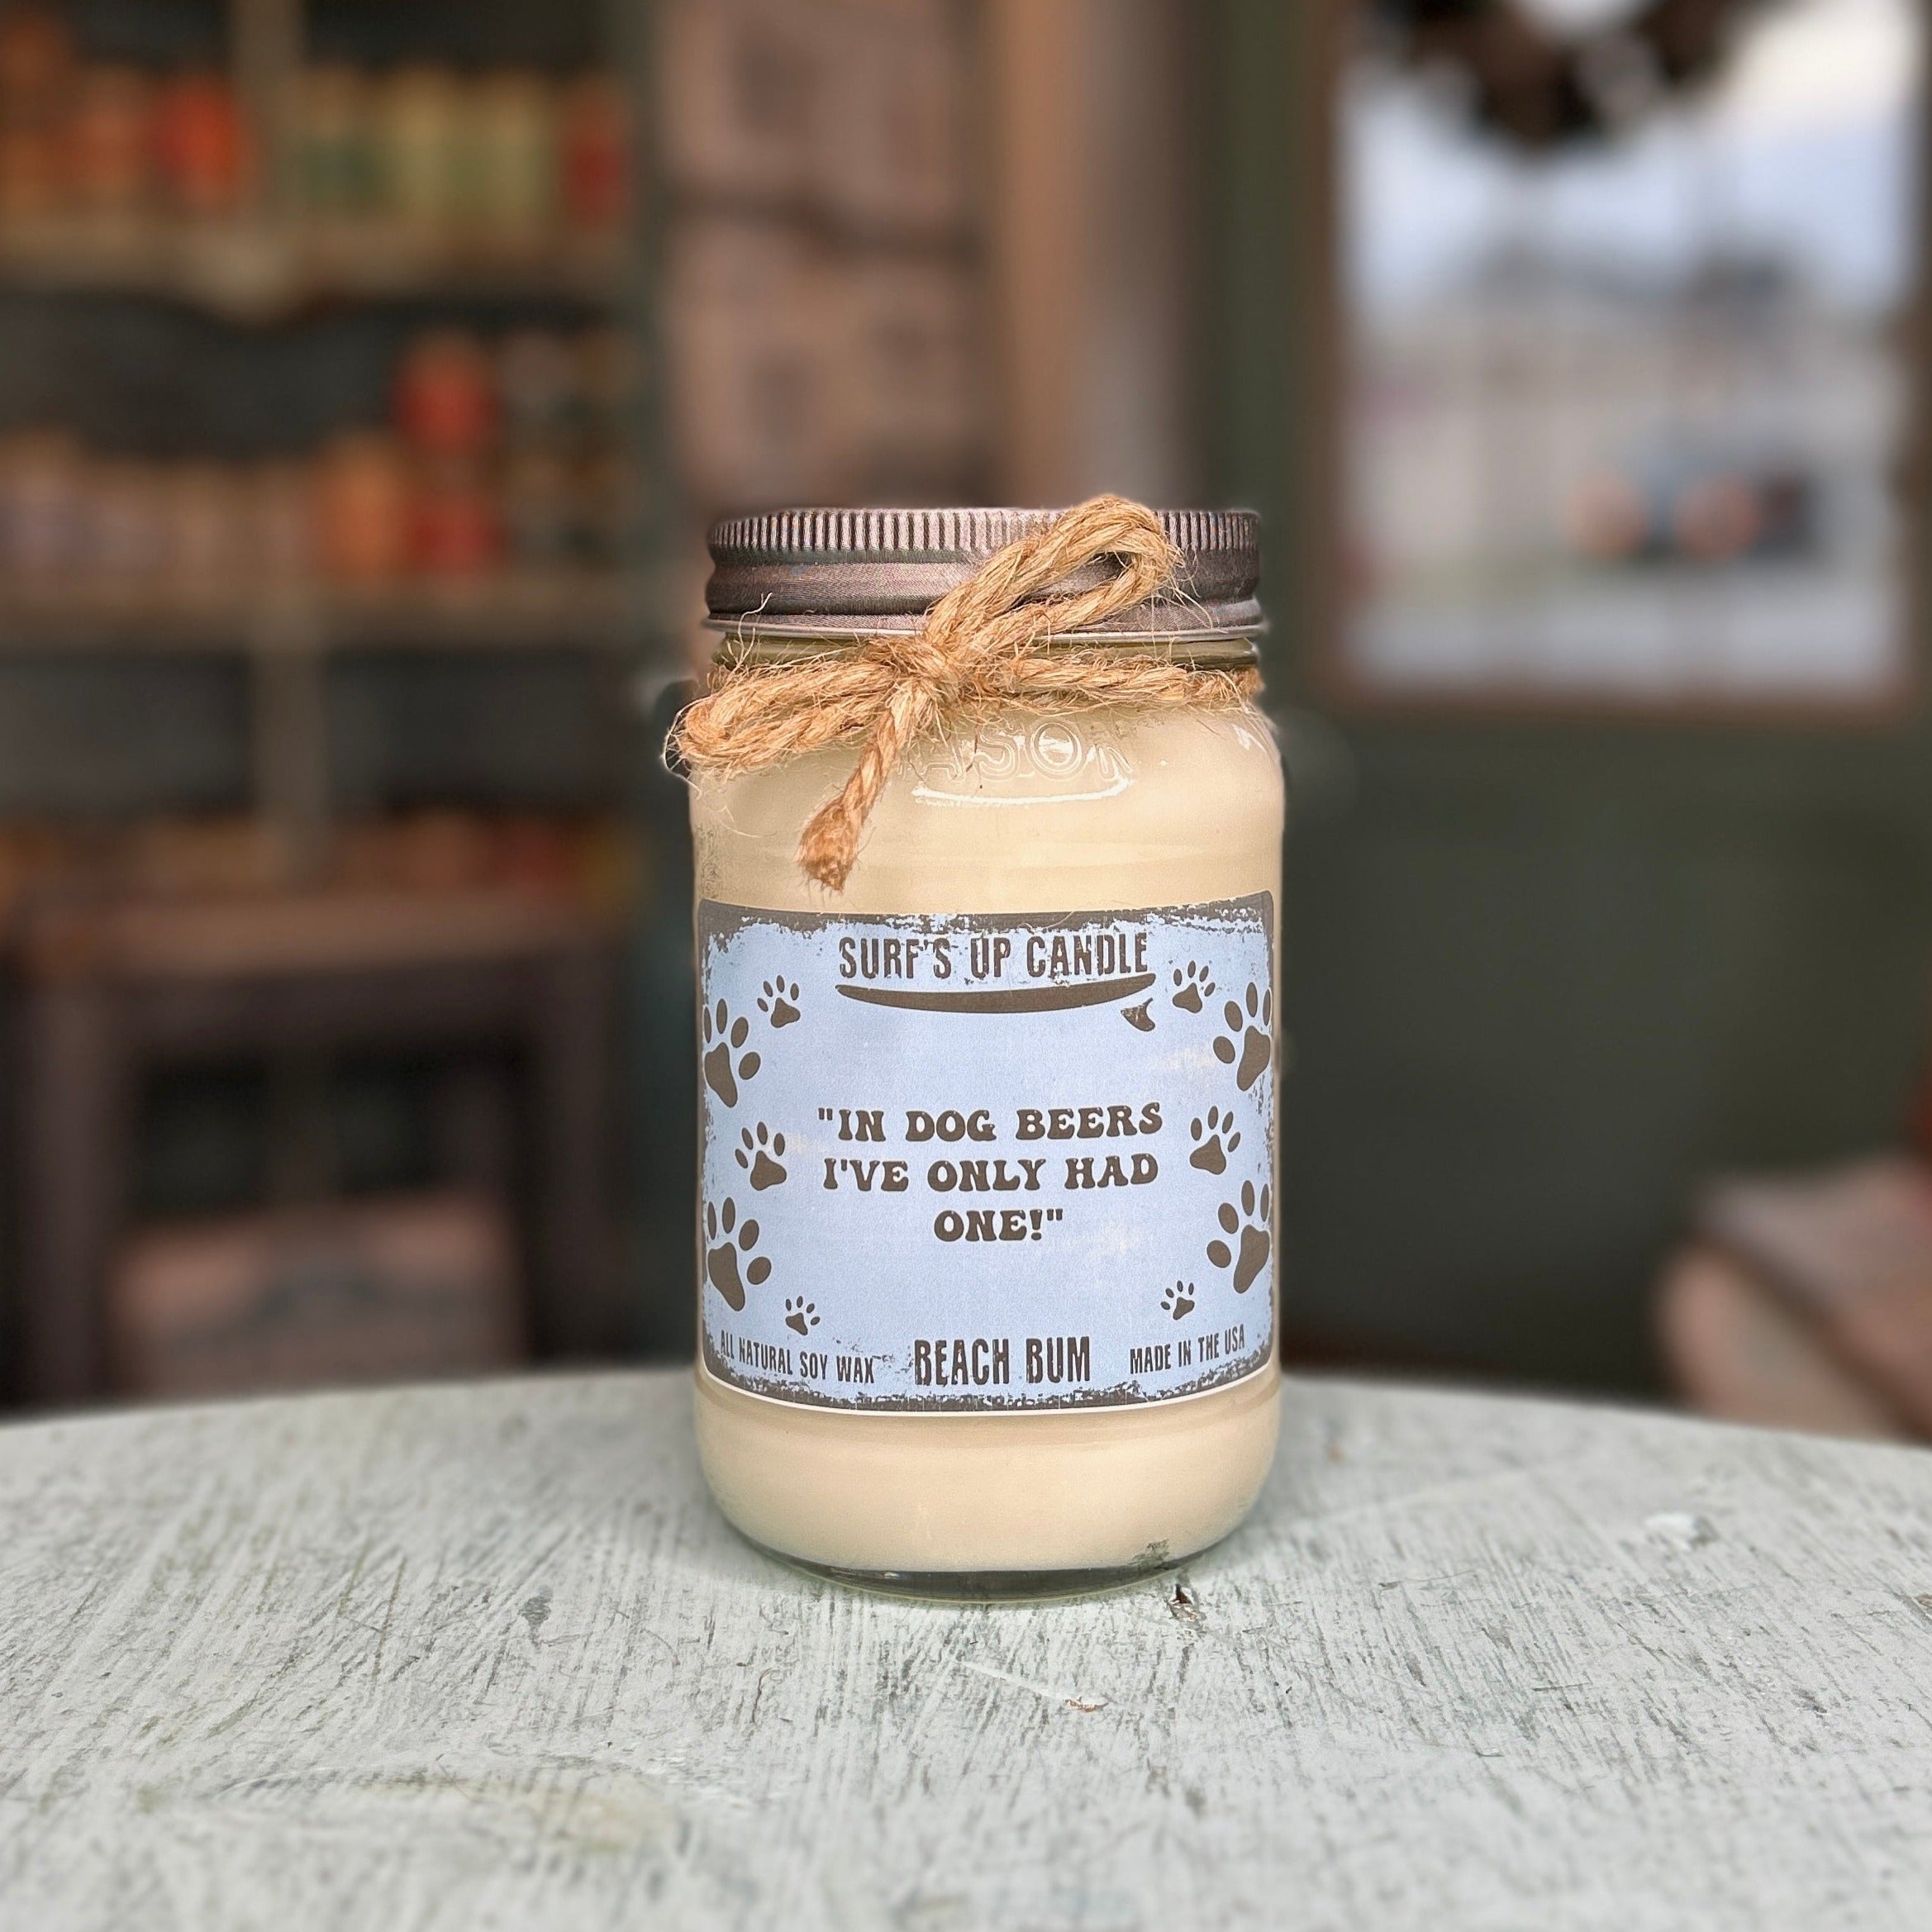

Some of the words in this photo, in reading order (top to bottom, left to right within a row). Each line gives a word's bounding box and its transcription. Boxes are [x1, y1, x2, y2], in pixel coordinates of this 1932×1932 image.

[839, 936, 952, 979] SURF'S
[970, 937, 1011, 980] UP
[1026, 932, 1149, 978] CANDLE
[818, 1108, 887, 1142] "IN
[905, 1109, 997, 1142] DOG
[1015, 1102, 1163, 1140] BEERS
[823, 1158, 909, 1192] I'VE
[926, 1159, 1046, 1192] ONLY
[1064, 1153, 1159, 1190] HAD
[934, 1208, 1064, 1242] ONE!"
[721, 1330, 735, 1359] ALL
[739, 1336, 793, 1375] NATURAL
[799, 1350, 827, 1380] SOY
[835, 1354, 875, 1383] WAX
[914, 1338, 1010, 1386] BEACH
[1025, 1335, 1091, 1384] BUM
[1130, 1343, 1172, 1375] MADE
[1178, 1340, 1192, 1367] IN
[1198, 1332, 1220, 1362] THE
[1224, 1323, 1245, 1354] USA
